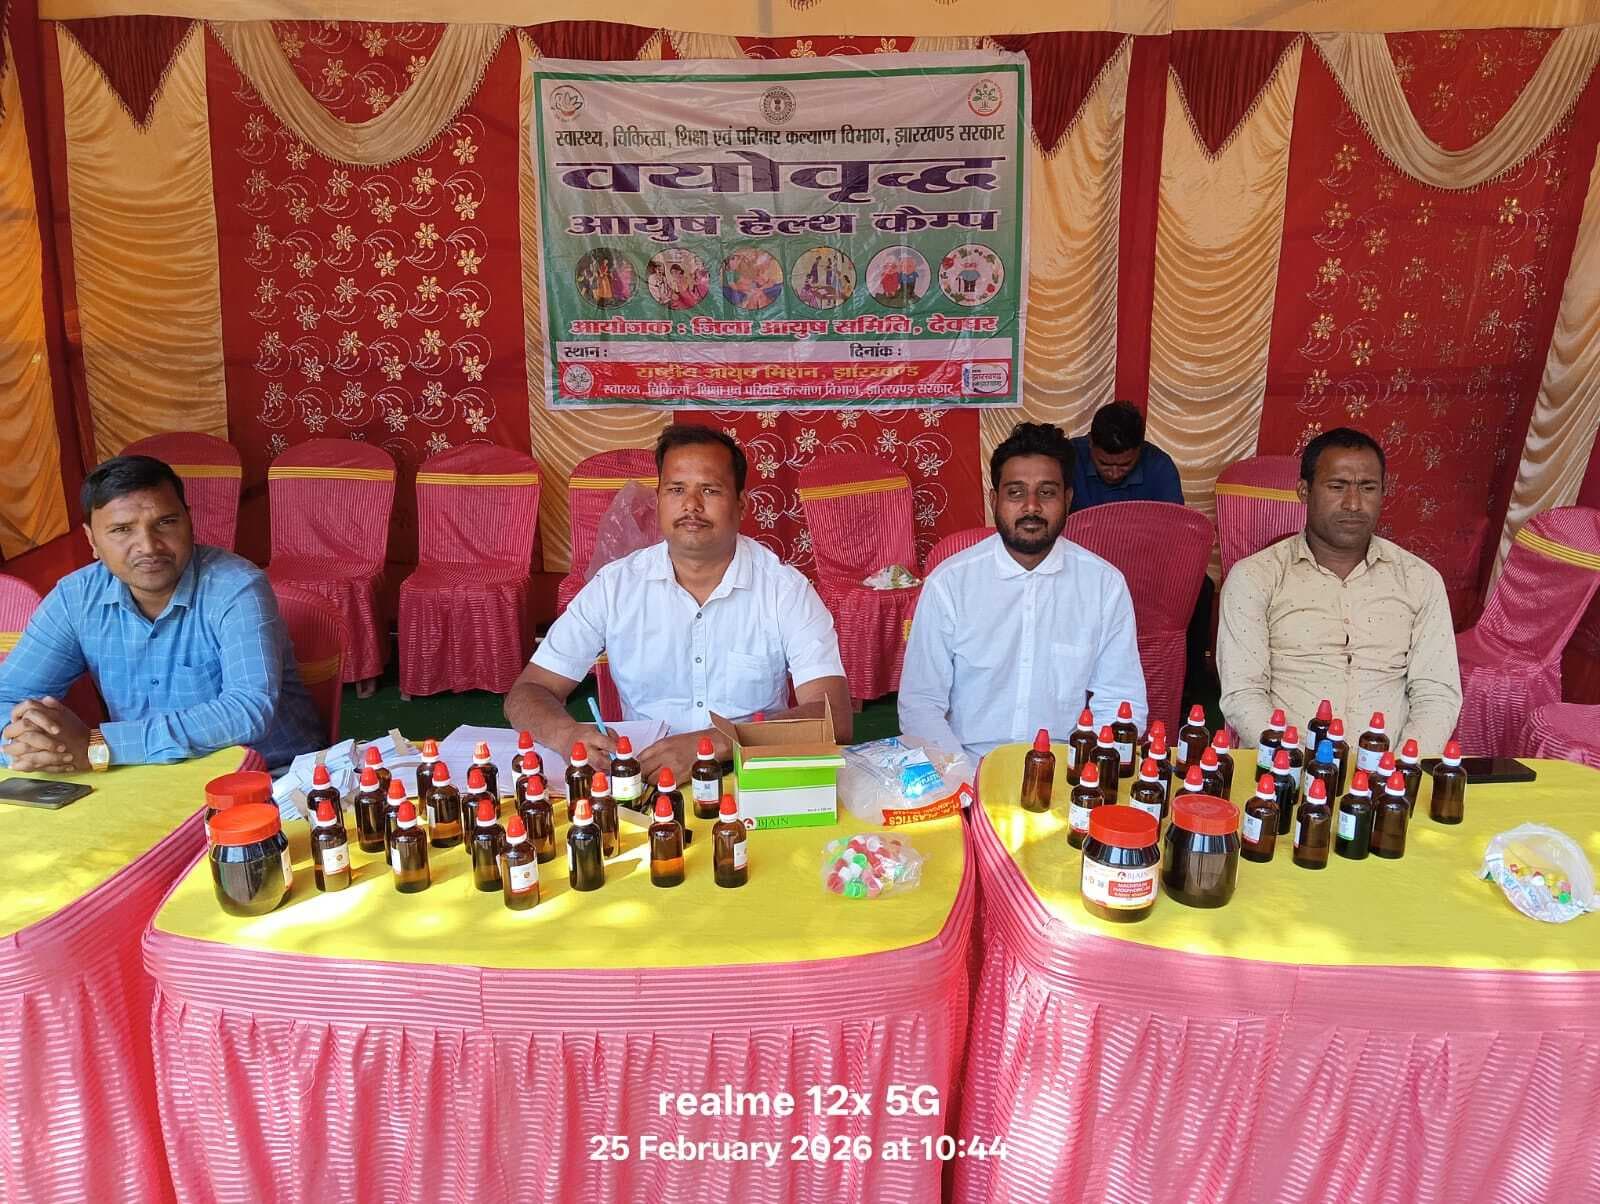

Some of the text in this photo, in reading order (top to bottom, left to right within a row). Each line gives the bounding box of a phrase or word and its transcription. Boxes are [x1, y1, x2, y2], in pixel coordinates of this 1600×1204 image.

[555, 124, 1006, 148] स्वास्थ्य, चिकित्सा, शिक्षा एवं परिवार कल्याण विभाग, झारखण्ड सरकार
[556, 151, 1006, 203] वयोवृद्ध
[567, 214, 721, 243] आयुष
[736, 208, 857, 236] हेल्थ
[571, 316, 672, 336] आयोजक
[690, 316, 752, 335] जिला
[759, 318, 829, 339] आयुष
[833, 315, 922, 335] समिति,
[705, 367, 759, 384] आयुष
[917, 382, 954, 395] सरकार
